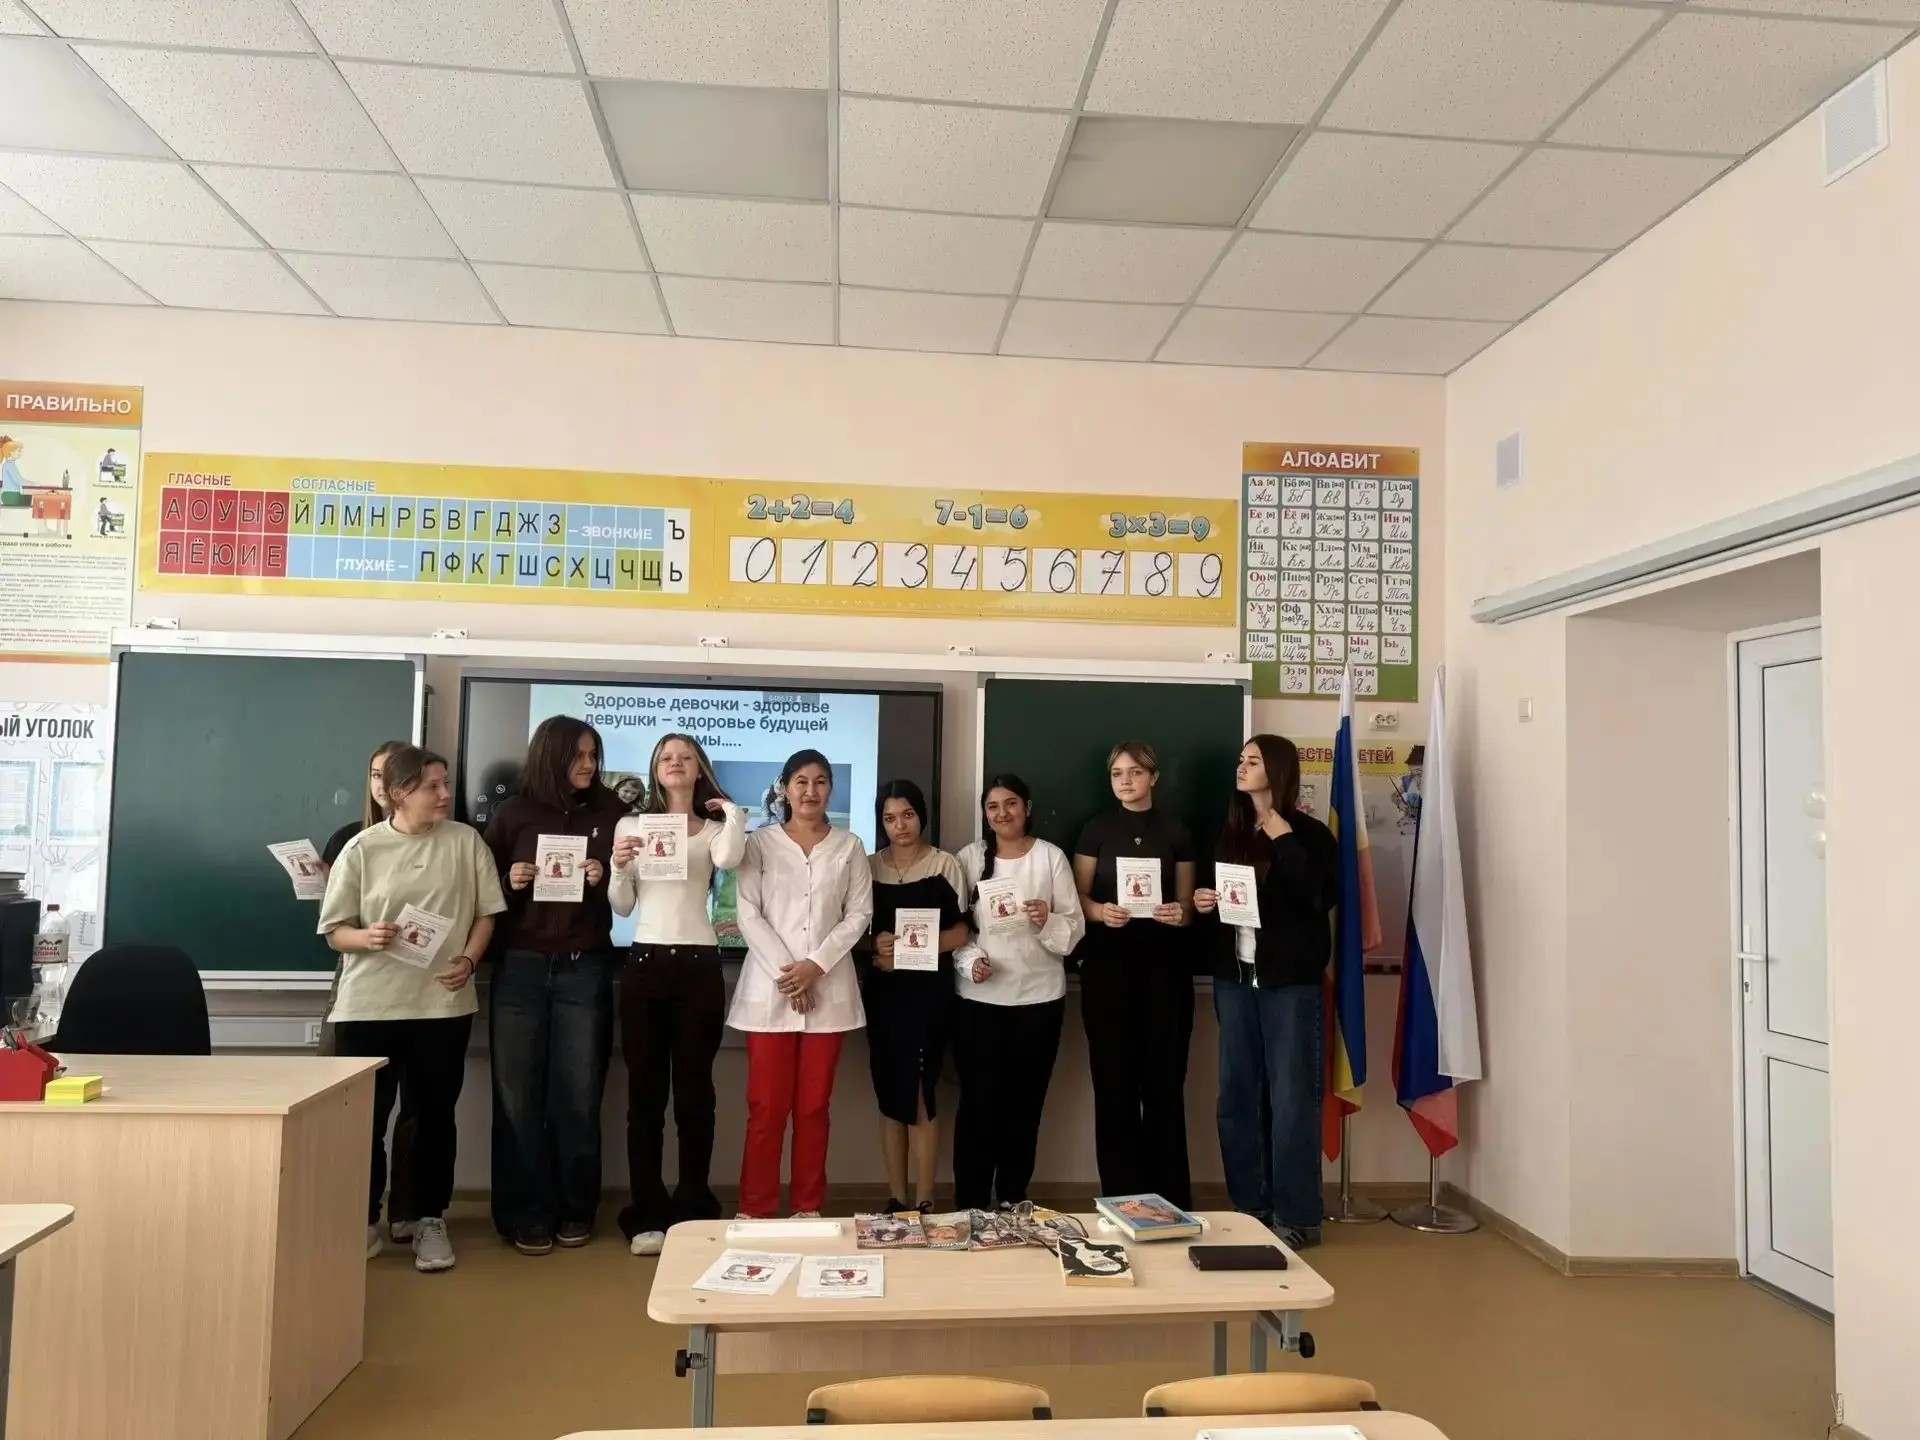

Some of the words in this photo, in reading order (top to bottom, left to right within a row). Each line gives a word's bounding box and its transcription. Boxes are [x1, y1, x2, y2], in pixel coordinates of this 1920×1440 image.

[6, 394, 132, 415] ПРАВИЛЬНО
[1281, 451, 1381, 469] АЛФАВИТ
[168, 473, 232, 486] ГЛАСНЫЕ
[291, 477, 376, 492] СОГЛАСНЫЕ
[166, 498, 182, 520] А
[191, 499, 208, 521] О
[218, 500, 233, 522] У
[242, 502, 261, 522] Ы
[268, 503, 284, 524] Э
[295, 498, 309, 524] Й
[320, 505, 335, 525] Л
[344, 505, 361, 526] М
[371, 507, 385, 527] Н
[397, 507, 411, 528] Р
[422, 509, 436, 529] Б
[447, 510, 461, 530] В
[473, 511, 486, 531] Г
[496, 512, 511, 536] Д
[518, 513, 540, 534] Ж
[548, 514, 561, 535] З
[581, 526, 652, 540] ЗВОНКИЕ
[667, 520, 685, 540] Ъ
[748, 493, 854, 524] 2+2=4
[935, 499, 1028, 530] 7-1=6
[164, 543, 179, 563] Я
[190, 539, 204, 564] Ё
[212, 544, 234, 566] Ю
[240, 545, 257, 566] И
[267, 546, 282, 567] Е
[336, 559, 395, 572] ГЛУХИЕ
[420, 551, 435, 572] П
[444, 552, 461, 573] Ф
[472, 553, 484, 574] К
[496, 554, 510, 574] Т
[519, 555, 538, 576] Ш
[546, 556, 561, 577] С
[570, 557, 585, 578] Х
[595, 558, 610, 584] Ц
[621, 560, 634, 580] Ч
[642, 560, 662, 587] Щ
[669, 562, 682, 582] Ь
[746, 537, 776, 583] 0
[801, 539, 827, 584] 1
[852, 541, 878, 586] 2
[901, 543, 928, 588] 3
[951, 545, 976, 590] 4
[1000, 547, 1027, 591] 5
[1049, 548, 1077, 593] 6
[1100, 550, 1124, 595] 7
[1145, 551, 1172, 596] 8
[1197, 553, 1222, 597] 9
[585, 693, 666, 710] Здоровье
[670, 698, 739, 711] девочки
[753, 700, 830, 715] здоровье
[26, 718, 95, 739] УГОЛОК
[584, 713, 656, 729] девушки
[677, 716, 756, 730] здоровье
[760, 717, 828, 733] будущей
[1359, 747, 1394, 764] ЕТЕЙ
